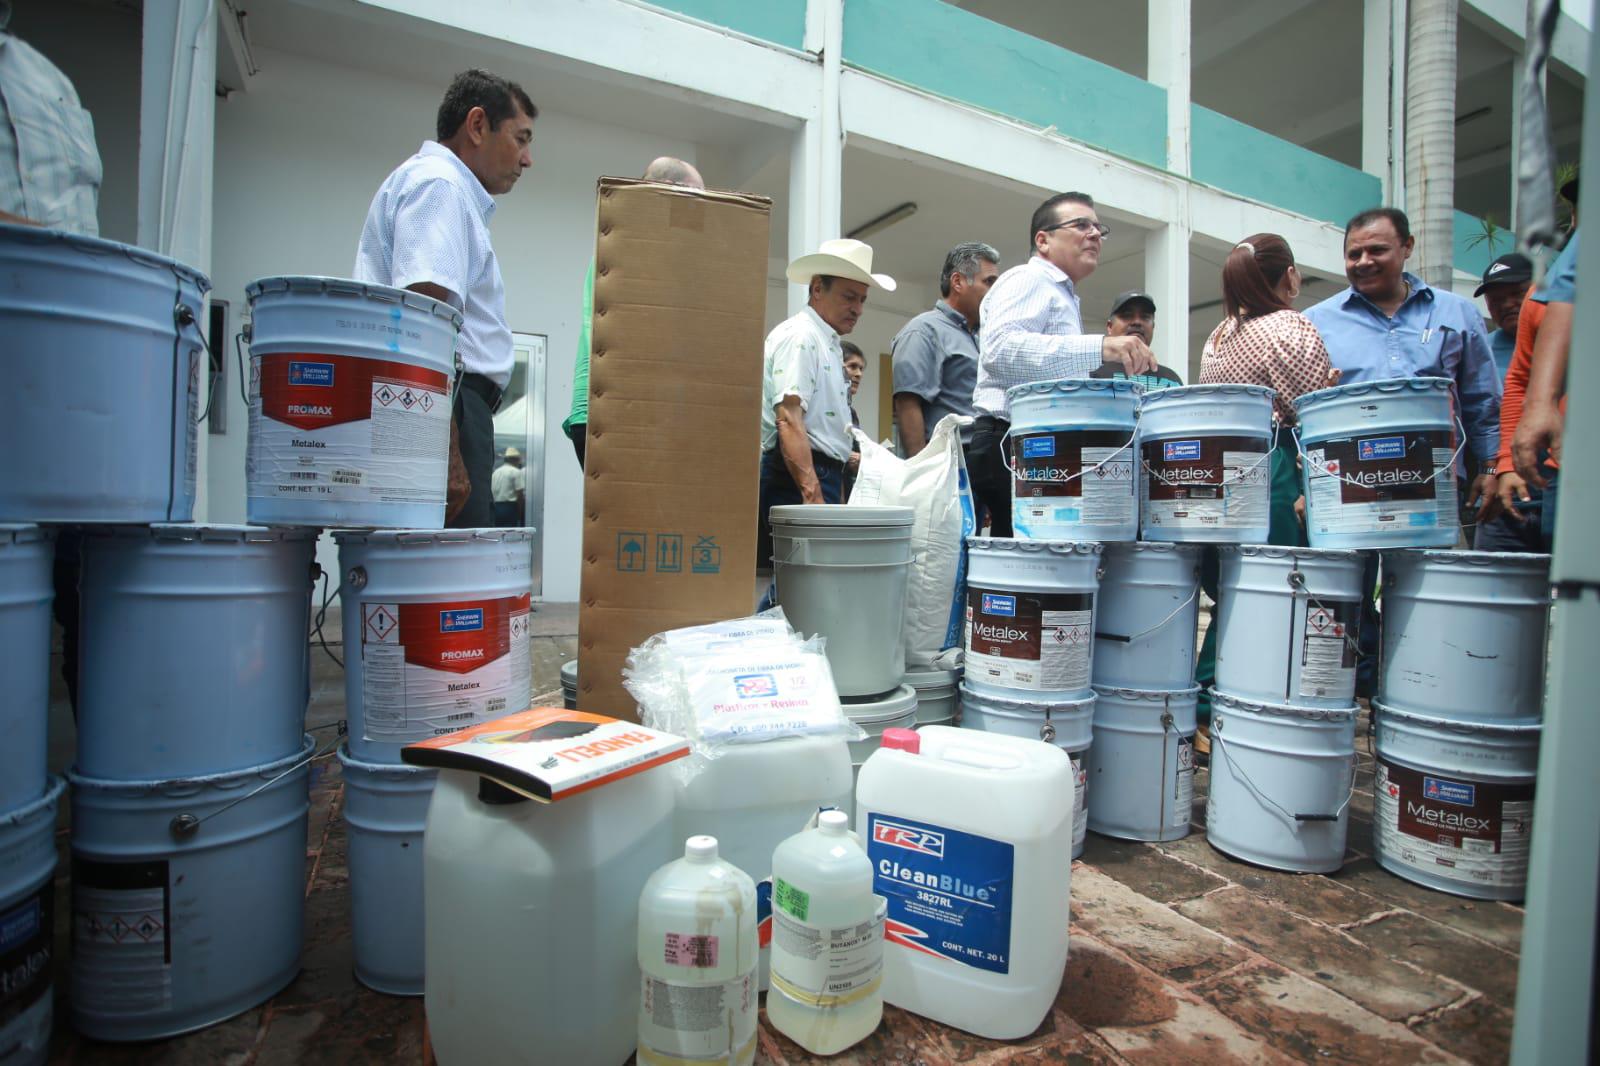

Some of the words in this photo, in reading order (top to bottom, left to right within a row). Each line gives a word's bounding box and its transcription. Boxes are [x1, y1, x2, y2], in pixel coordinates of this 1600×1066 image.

[288, 405, 332, 415] PROMAX
[291, 439, 327, 448] Metalex
[1016, 466, 1069, 481] Metalex
[1154, 467, 1214, 482] Metalex
[1346, 467, 1423, 486] Metalex
[973, 621, 1028, 641] Metalex
[441, 649, 484, 661] PROMAX
[448, 681, 481, 692] Metalex
[555, 730, 656, 763] FANDELI
[1407, 800, 1491, 831] Metalex
[917, 890, 952, 908] 3827RL
[942, 941, 966, 954] CONT.
[967, 947, 986, 959] NET.
[986, 953, 999, 962] 20
[999, 954, 1005, 964] L
